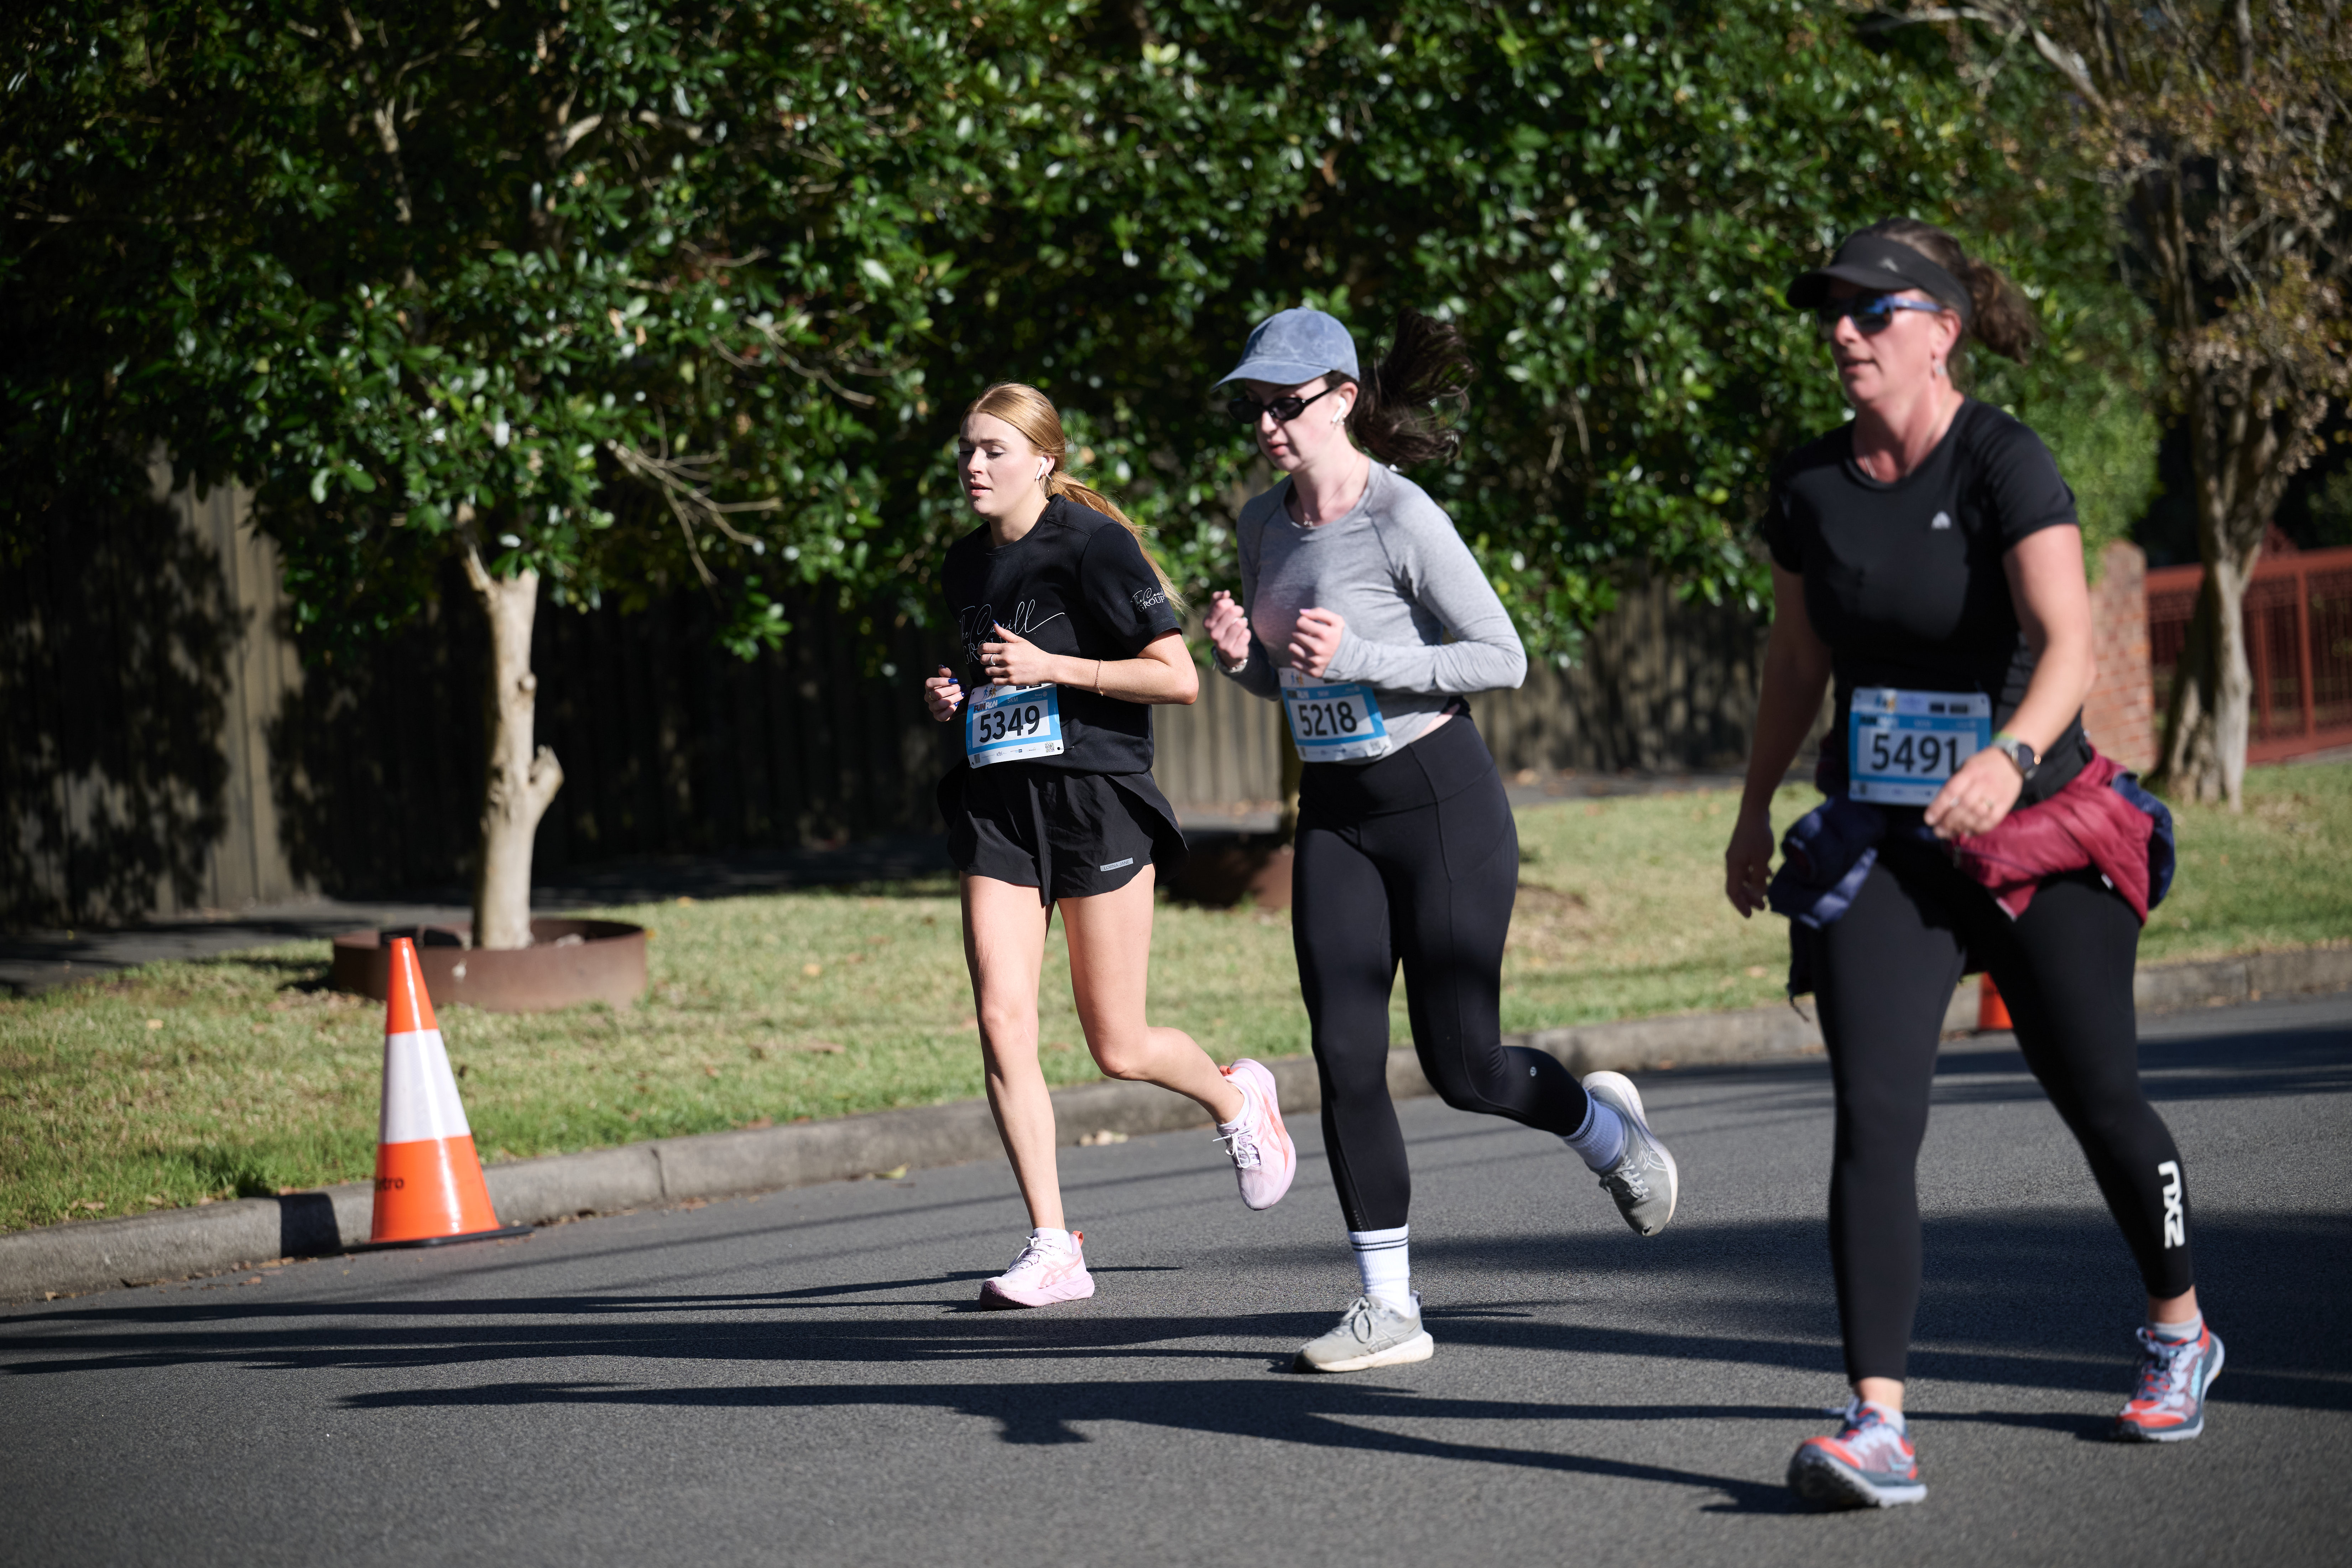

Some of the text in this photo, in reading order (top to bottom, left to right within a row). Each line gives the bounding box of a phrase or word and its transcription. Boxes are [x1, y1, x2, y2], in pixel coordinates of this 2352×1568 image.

[1130, 590, 1142, 611] The
[1138, 596, 1165, 612] GROUP
[979, 705, 1040, 743] 5349
[1298, 701, 1357, 736] 5218
[1871, 733, 1961, 774] 5491
